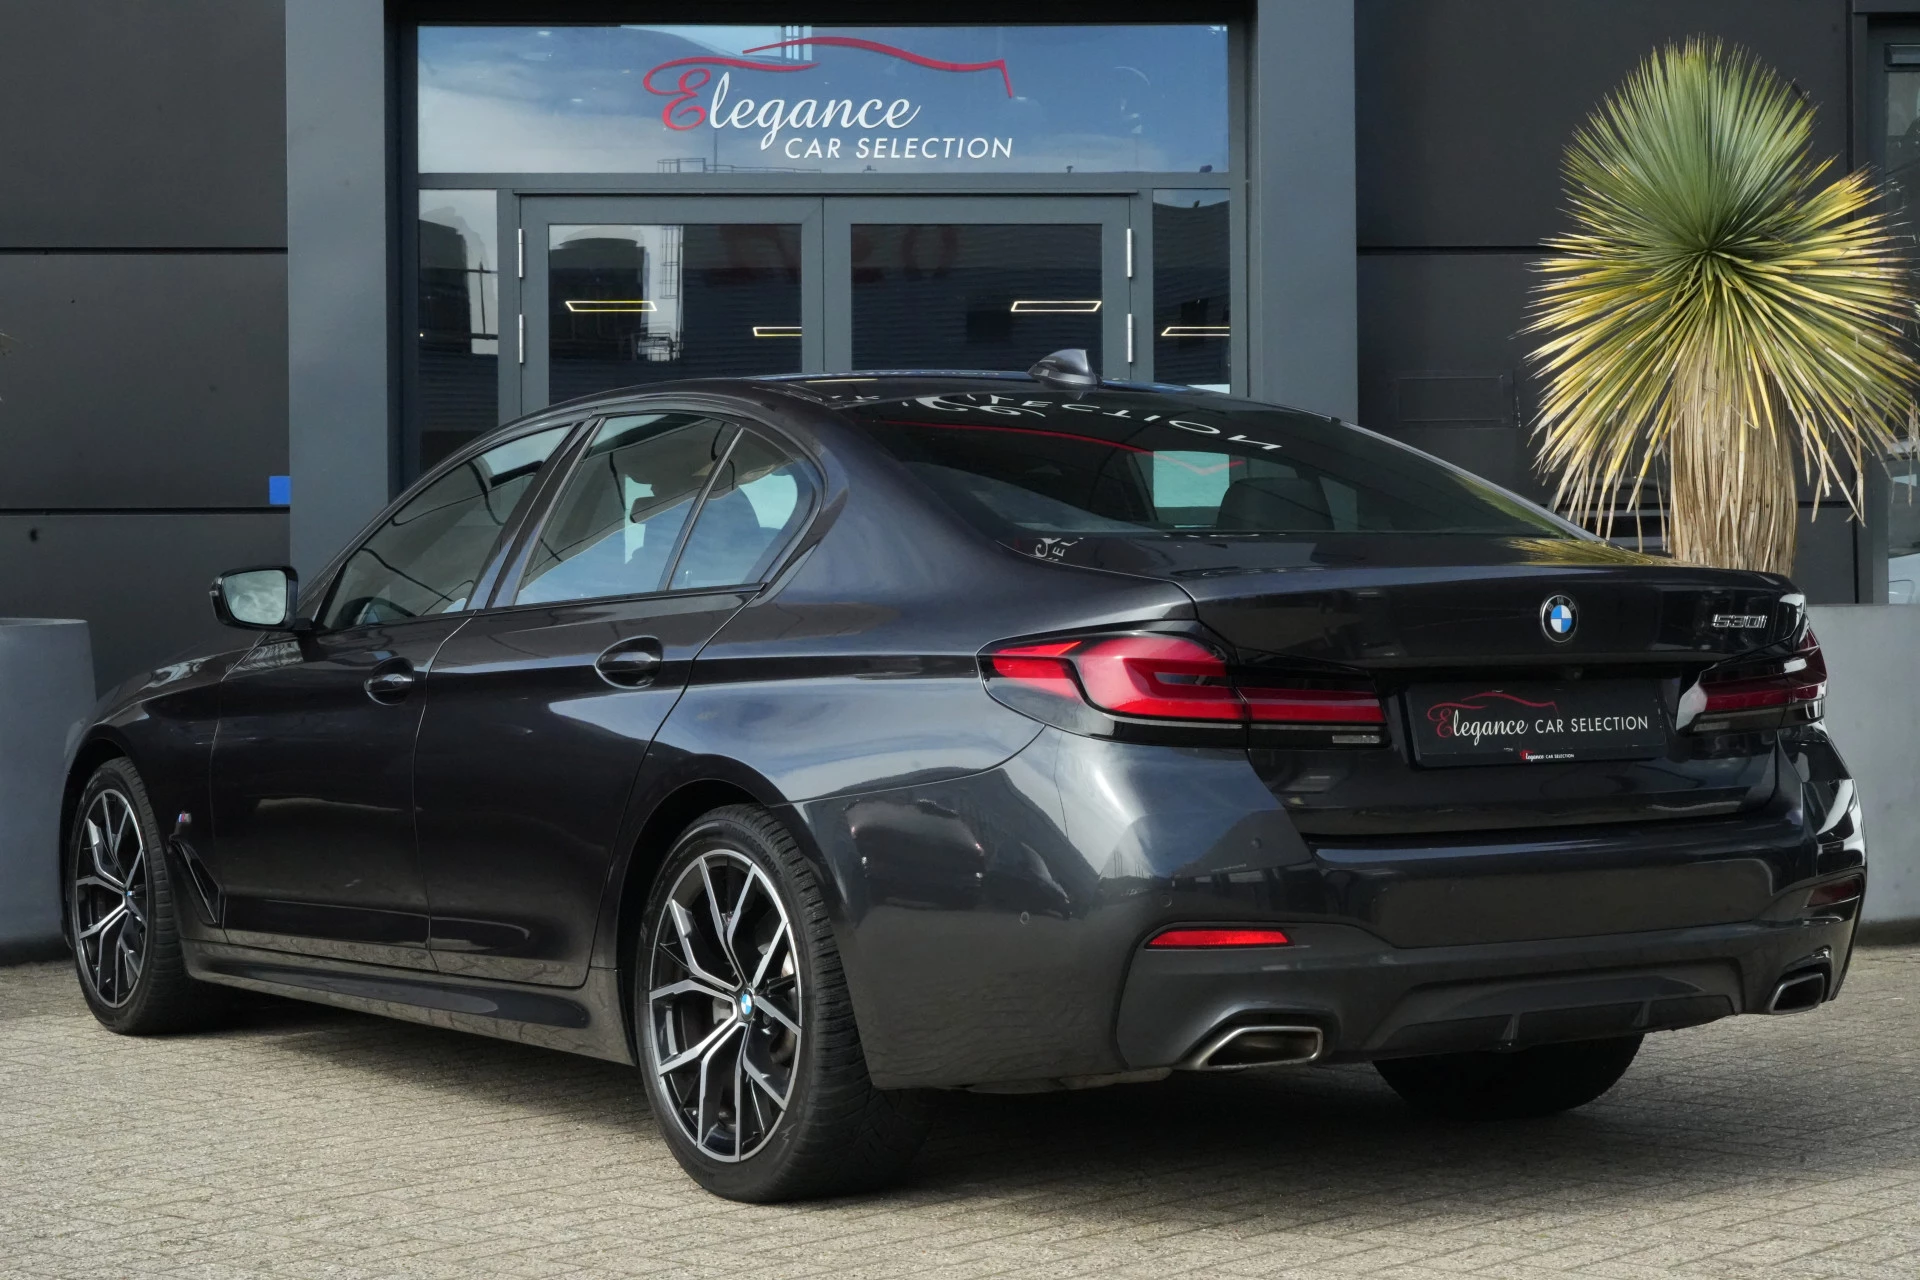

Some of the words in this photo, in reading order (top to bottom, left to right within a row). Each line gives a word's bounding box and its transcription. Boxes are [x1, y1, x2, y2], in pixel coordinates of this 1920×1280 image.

[645, 66, 921, 151] Elegance
[784, 137, 841, 159] CAR
[855, 137, 1013, 159] SELECTION
[1712, 614, 1768, 629] 530i
[1430, 706, 1529, 746] Elegance
[1535, 718, 1565, 734] CAR
[1571, 715, 1649, 732] SELECTION
